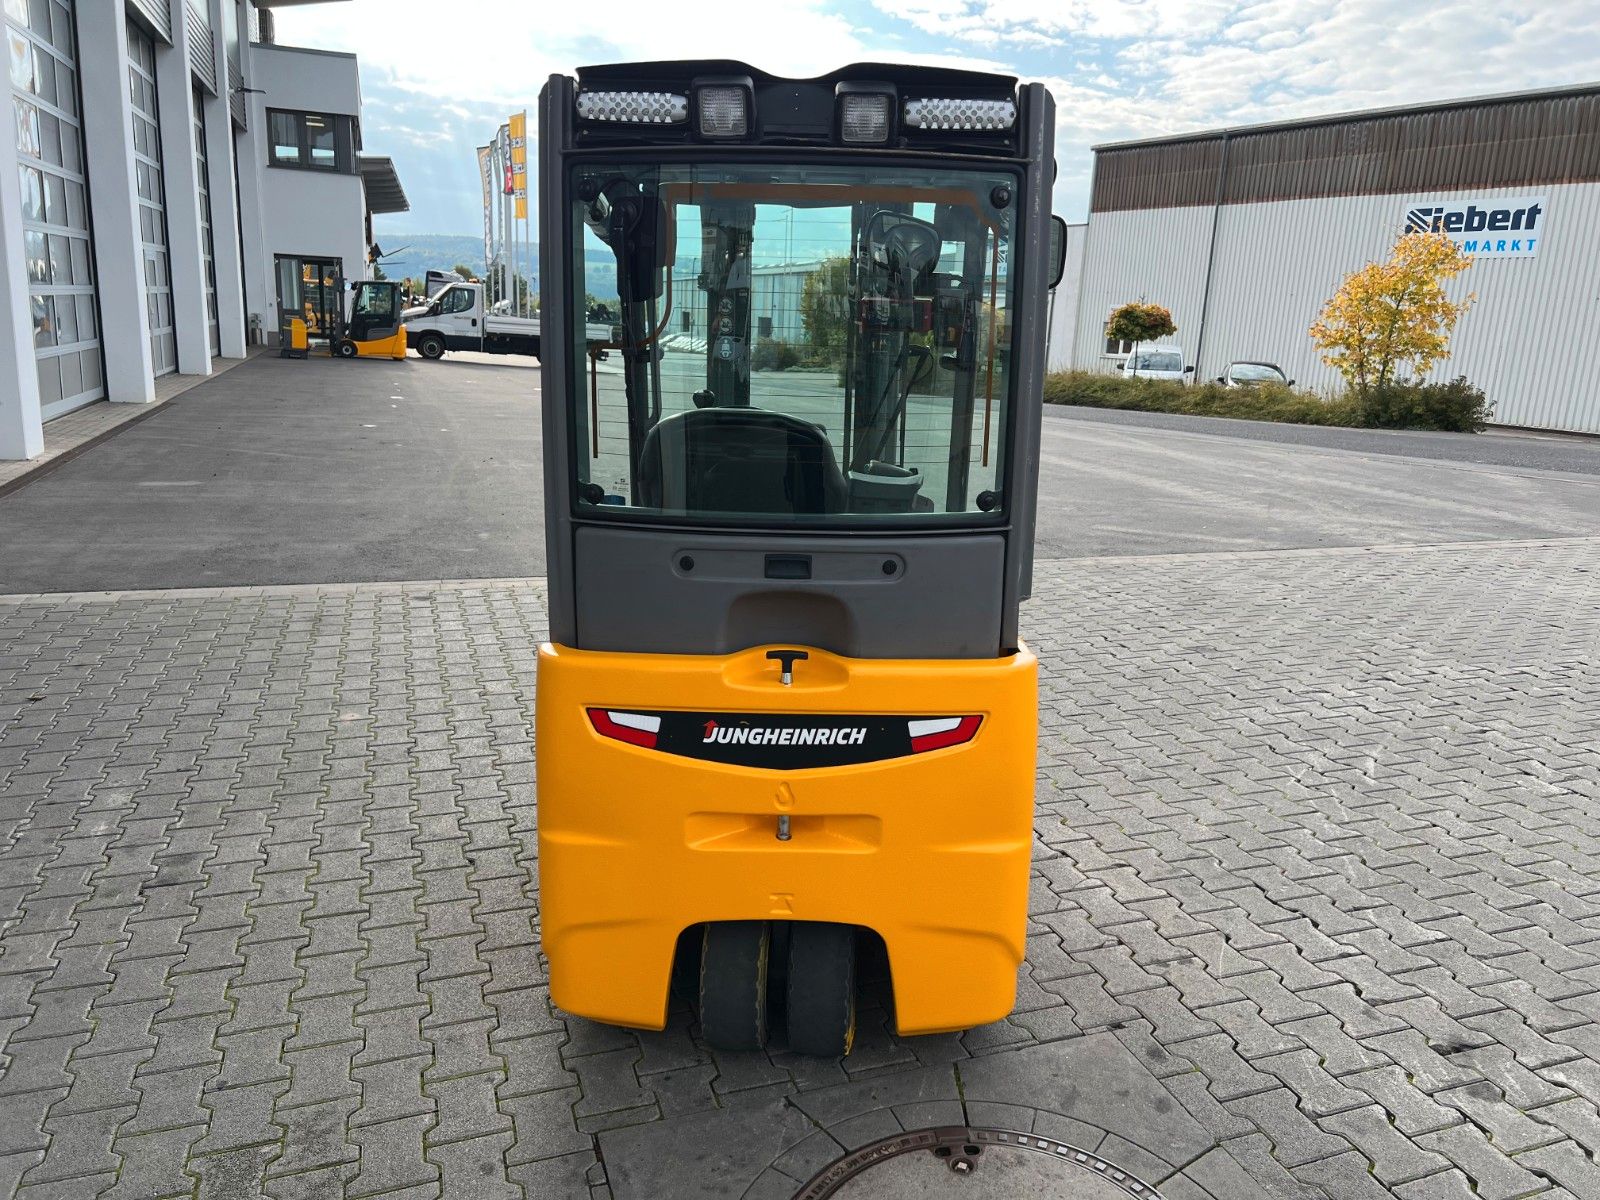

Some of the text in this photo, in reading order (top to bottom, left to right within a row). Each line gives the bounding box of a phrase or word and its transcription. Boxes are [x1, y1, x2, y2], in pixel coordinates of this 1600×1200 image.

[1404, 203, 1542, 234] Siebert
[1453, 239, 1537, 252] MARKT
[703, 726, 868, 745] JUNGHEINRICH
